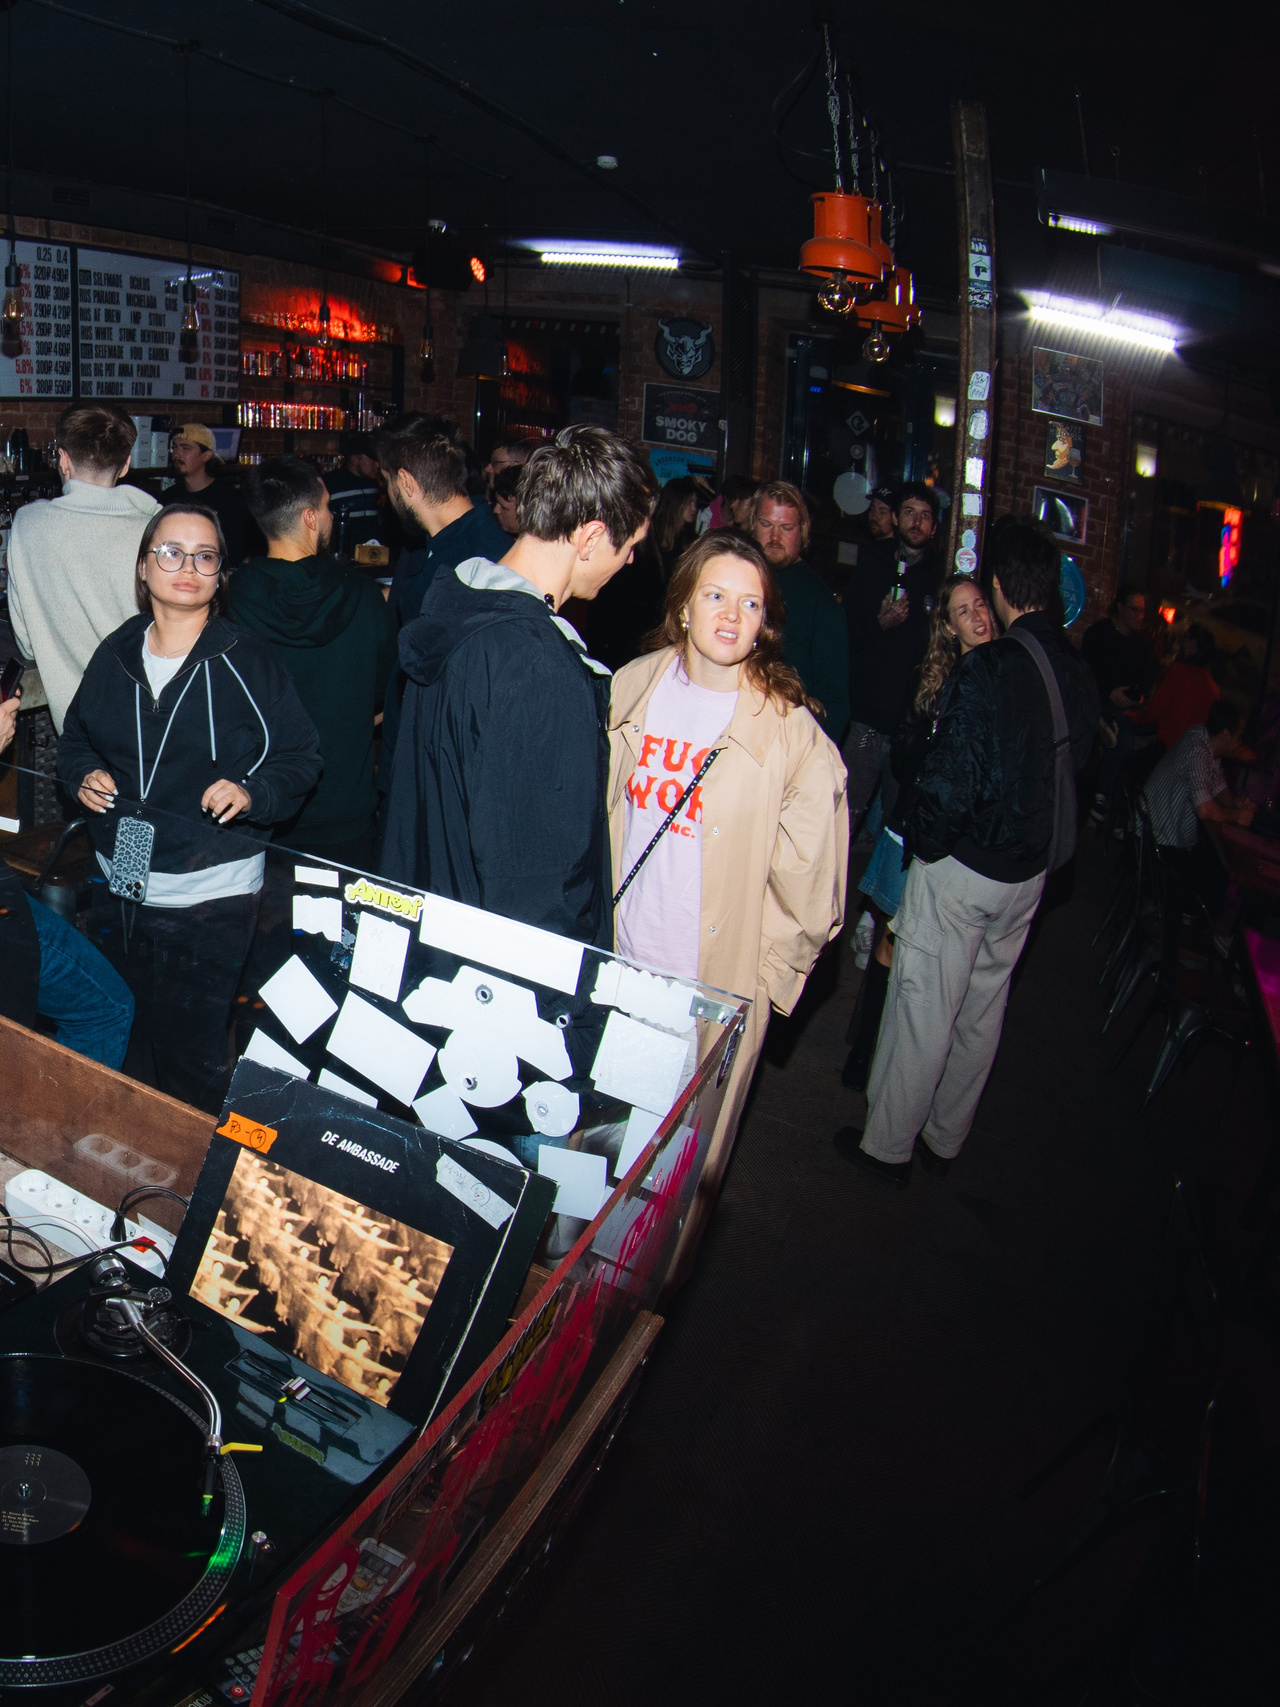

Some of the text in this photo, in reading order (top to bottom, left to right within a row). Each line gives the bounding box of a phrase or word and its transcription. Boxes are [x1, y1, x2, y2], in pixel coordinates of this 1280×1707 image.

[37, 247, 67, 263] 0.25 0.4
[34, 266, 51, 280] 320₽
[52, 267, 68, 282] 490₽
[93, 272, 123, 288] SELFMADE
[94, 290, 120, 305] PARADOX
[34, 304, 51, 318] 290₽
[52, 305, 71, 319] 420₽
[105, 309, 121, 323] BREW
[15, 359, 33, 374] 5.8%
[54, 360, 71, 375] 450₽
[20, 379, 32, 393] 6%
[655, 416, 708, 433] SMOKY
[666, 429, 697, 443] DOG
[344, 877, 424, 923] ANTON
[321, 1131, 400, 1173] DE AMBASSADE
